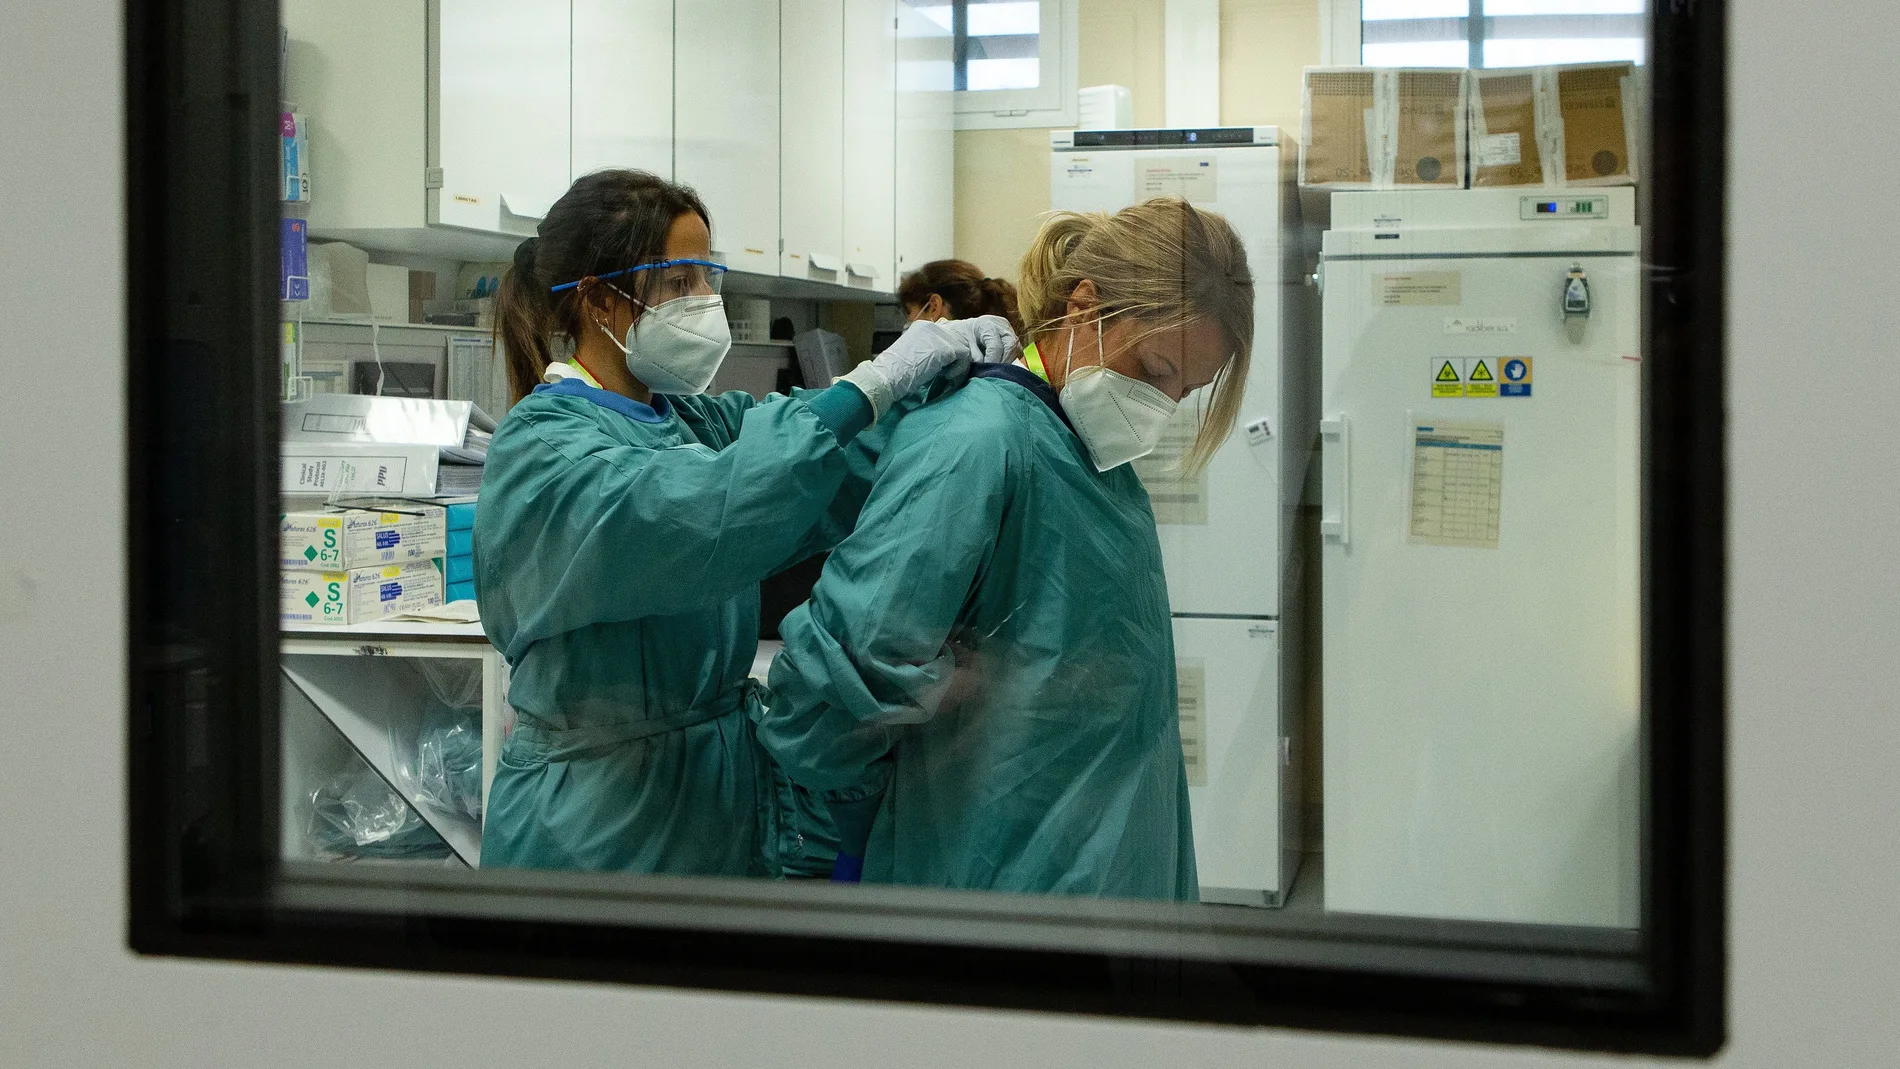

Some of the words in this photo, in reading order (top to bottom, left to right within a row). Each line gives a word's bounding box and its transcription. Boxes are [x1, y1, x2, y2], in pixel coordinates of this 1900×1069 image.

[299, 462, 307, 485] Clinical
[306, 465, 314, 483] Study
[312, 461, 321, 487] Protocol
[323, 528, 337, 549] S
[320, 548, 340, 561] 6-7
[327, 582, 341, 602] S
[323, 602, 344, 615] 6-7
